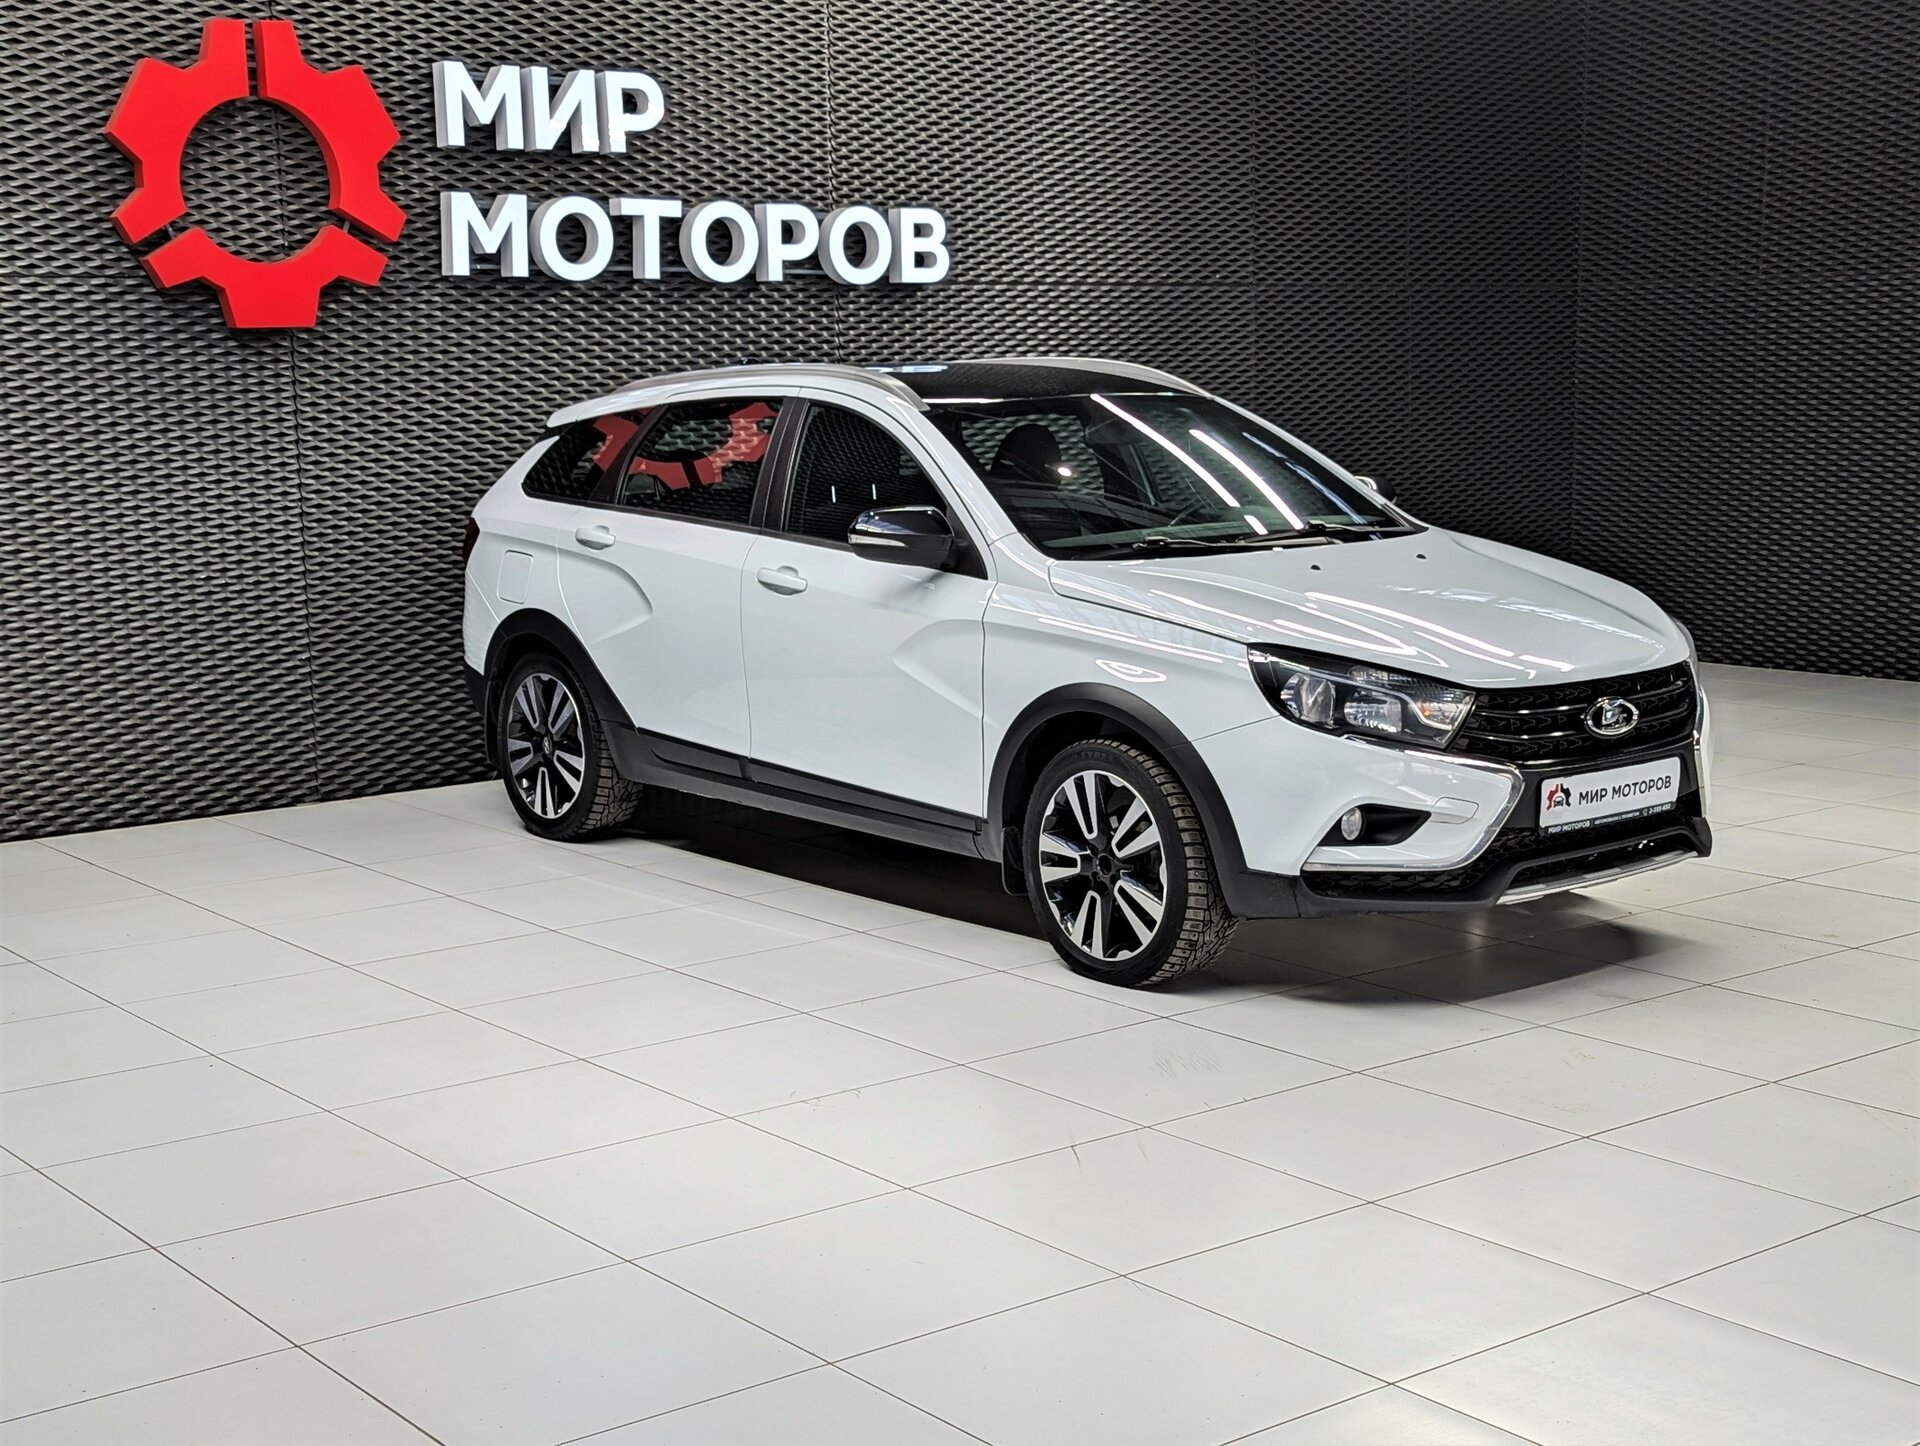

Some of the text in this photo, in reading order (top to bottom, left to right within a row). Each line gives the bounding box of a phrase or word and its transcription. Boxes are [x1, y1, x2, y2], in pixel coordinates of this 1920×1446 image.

[433, 60, 665, 154] МИР
[440, 191, 951, 285] МОТОРОВ
[1578, 775, 1672, 806] МИР МОТОРОВ
